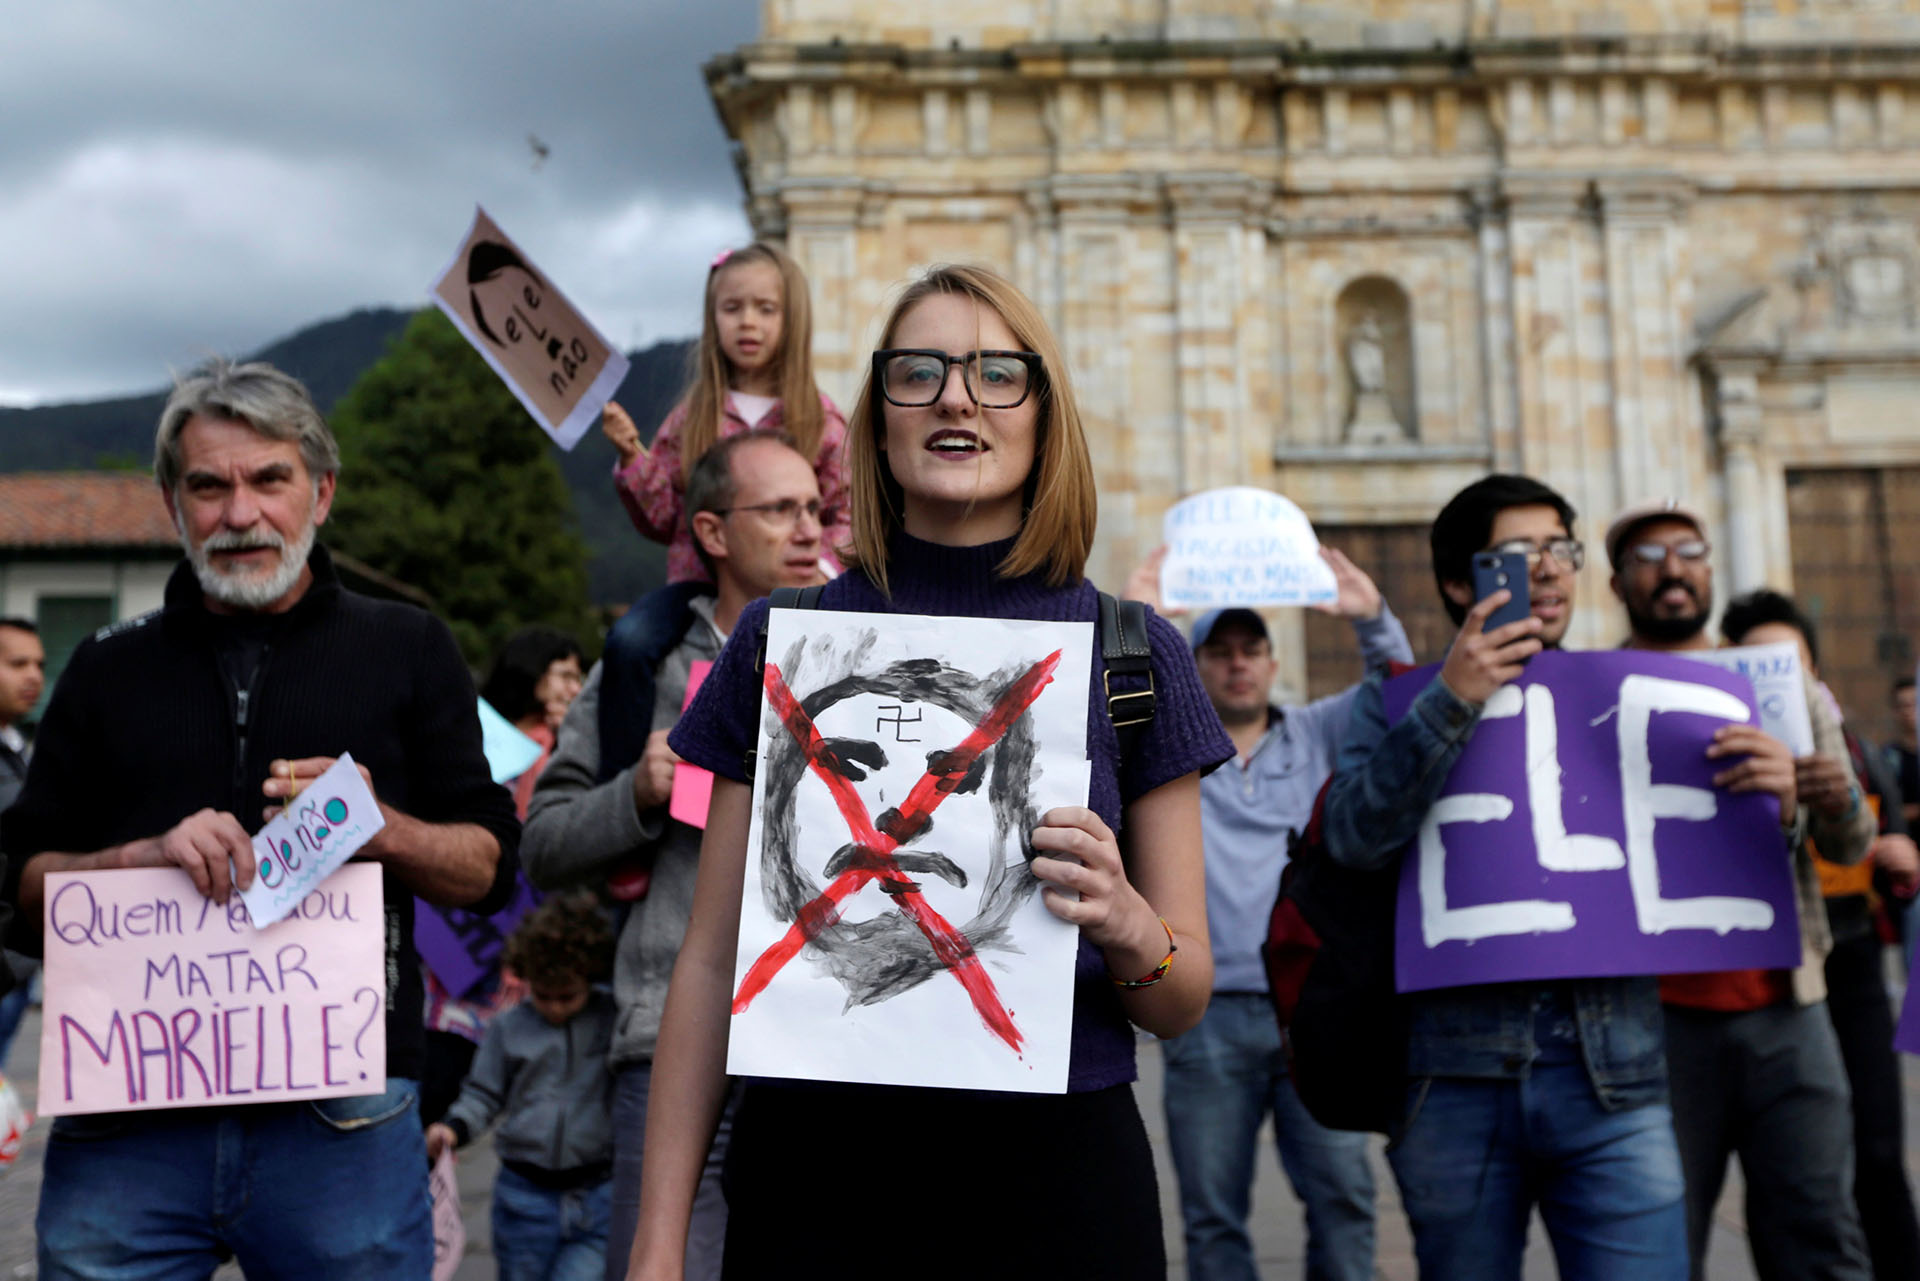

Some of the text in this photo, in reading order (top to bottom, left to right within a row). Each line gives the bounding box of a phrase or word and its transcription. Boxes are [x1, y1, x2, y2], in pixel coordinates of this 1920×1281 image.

[1418, 674, 1774, 947] ELE
[51, 881, 182, 946] Quem
[144, 944, 318, 1000] MATAR
